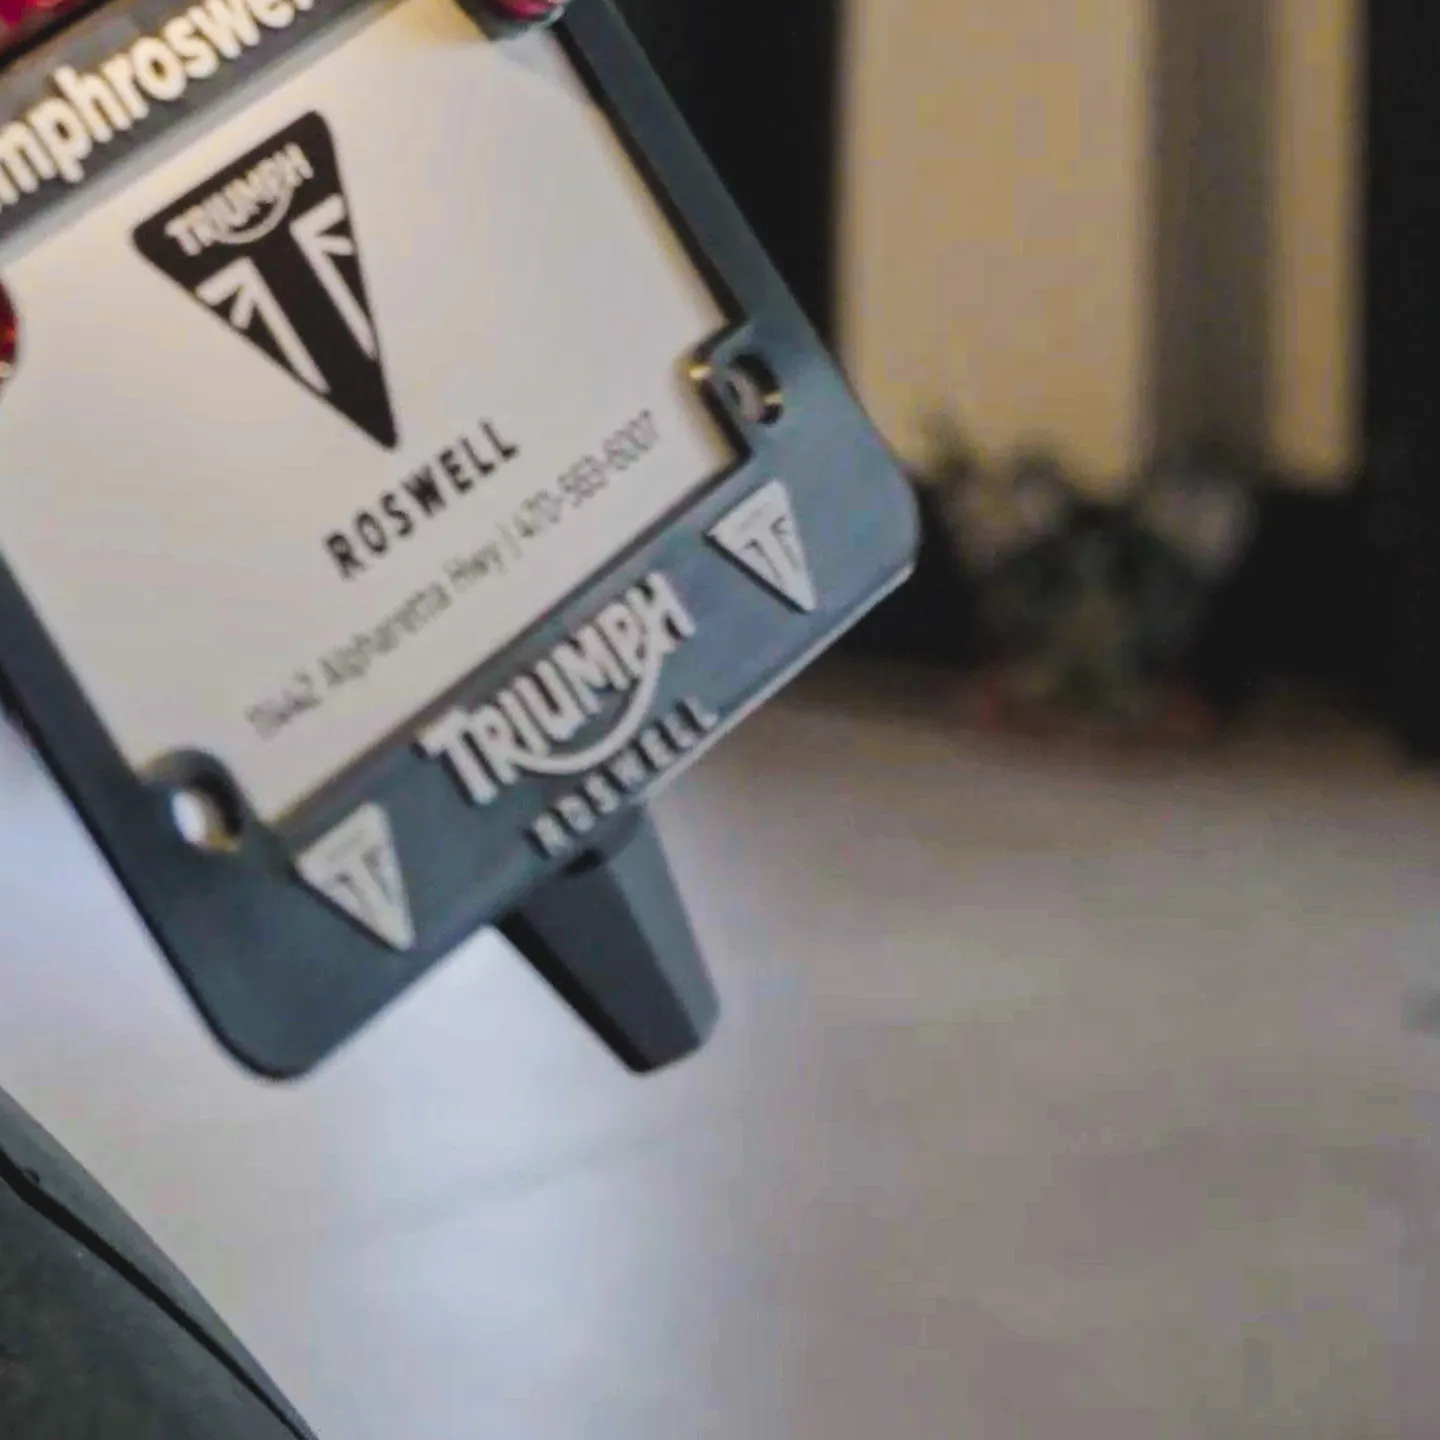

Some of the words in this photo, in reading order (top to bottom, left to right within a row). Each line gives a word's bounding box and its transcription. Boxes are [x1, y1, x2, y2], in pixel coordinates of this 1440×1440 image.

[164, 141, 315, 257] TRIUMPH
[322, 417, 519, 580] ROSWELL
[412, 571, 696, 808] TRIUMPH
[526, 697, 719, 858] ROSWELL
